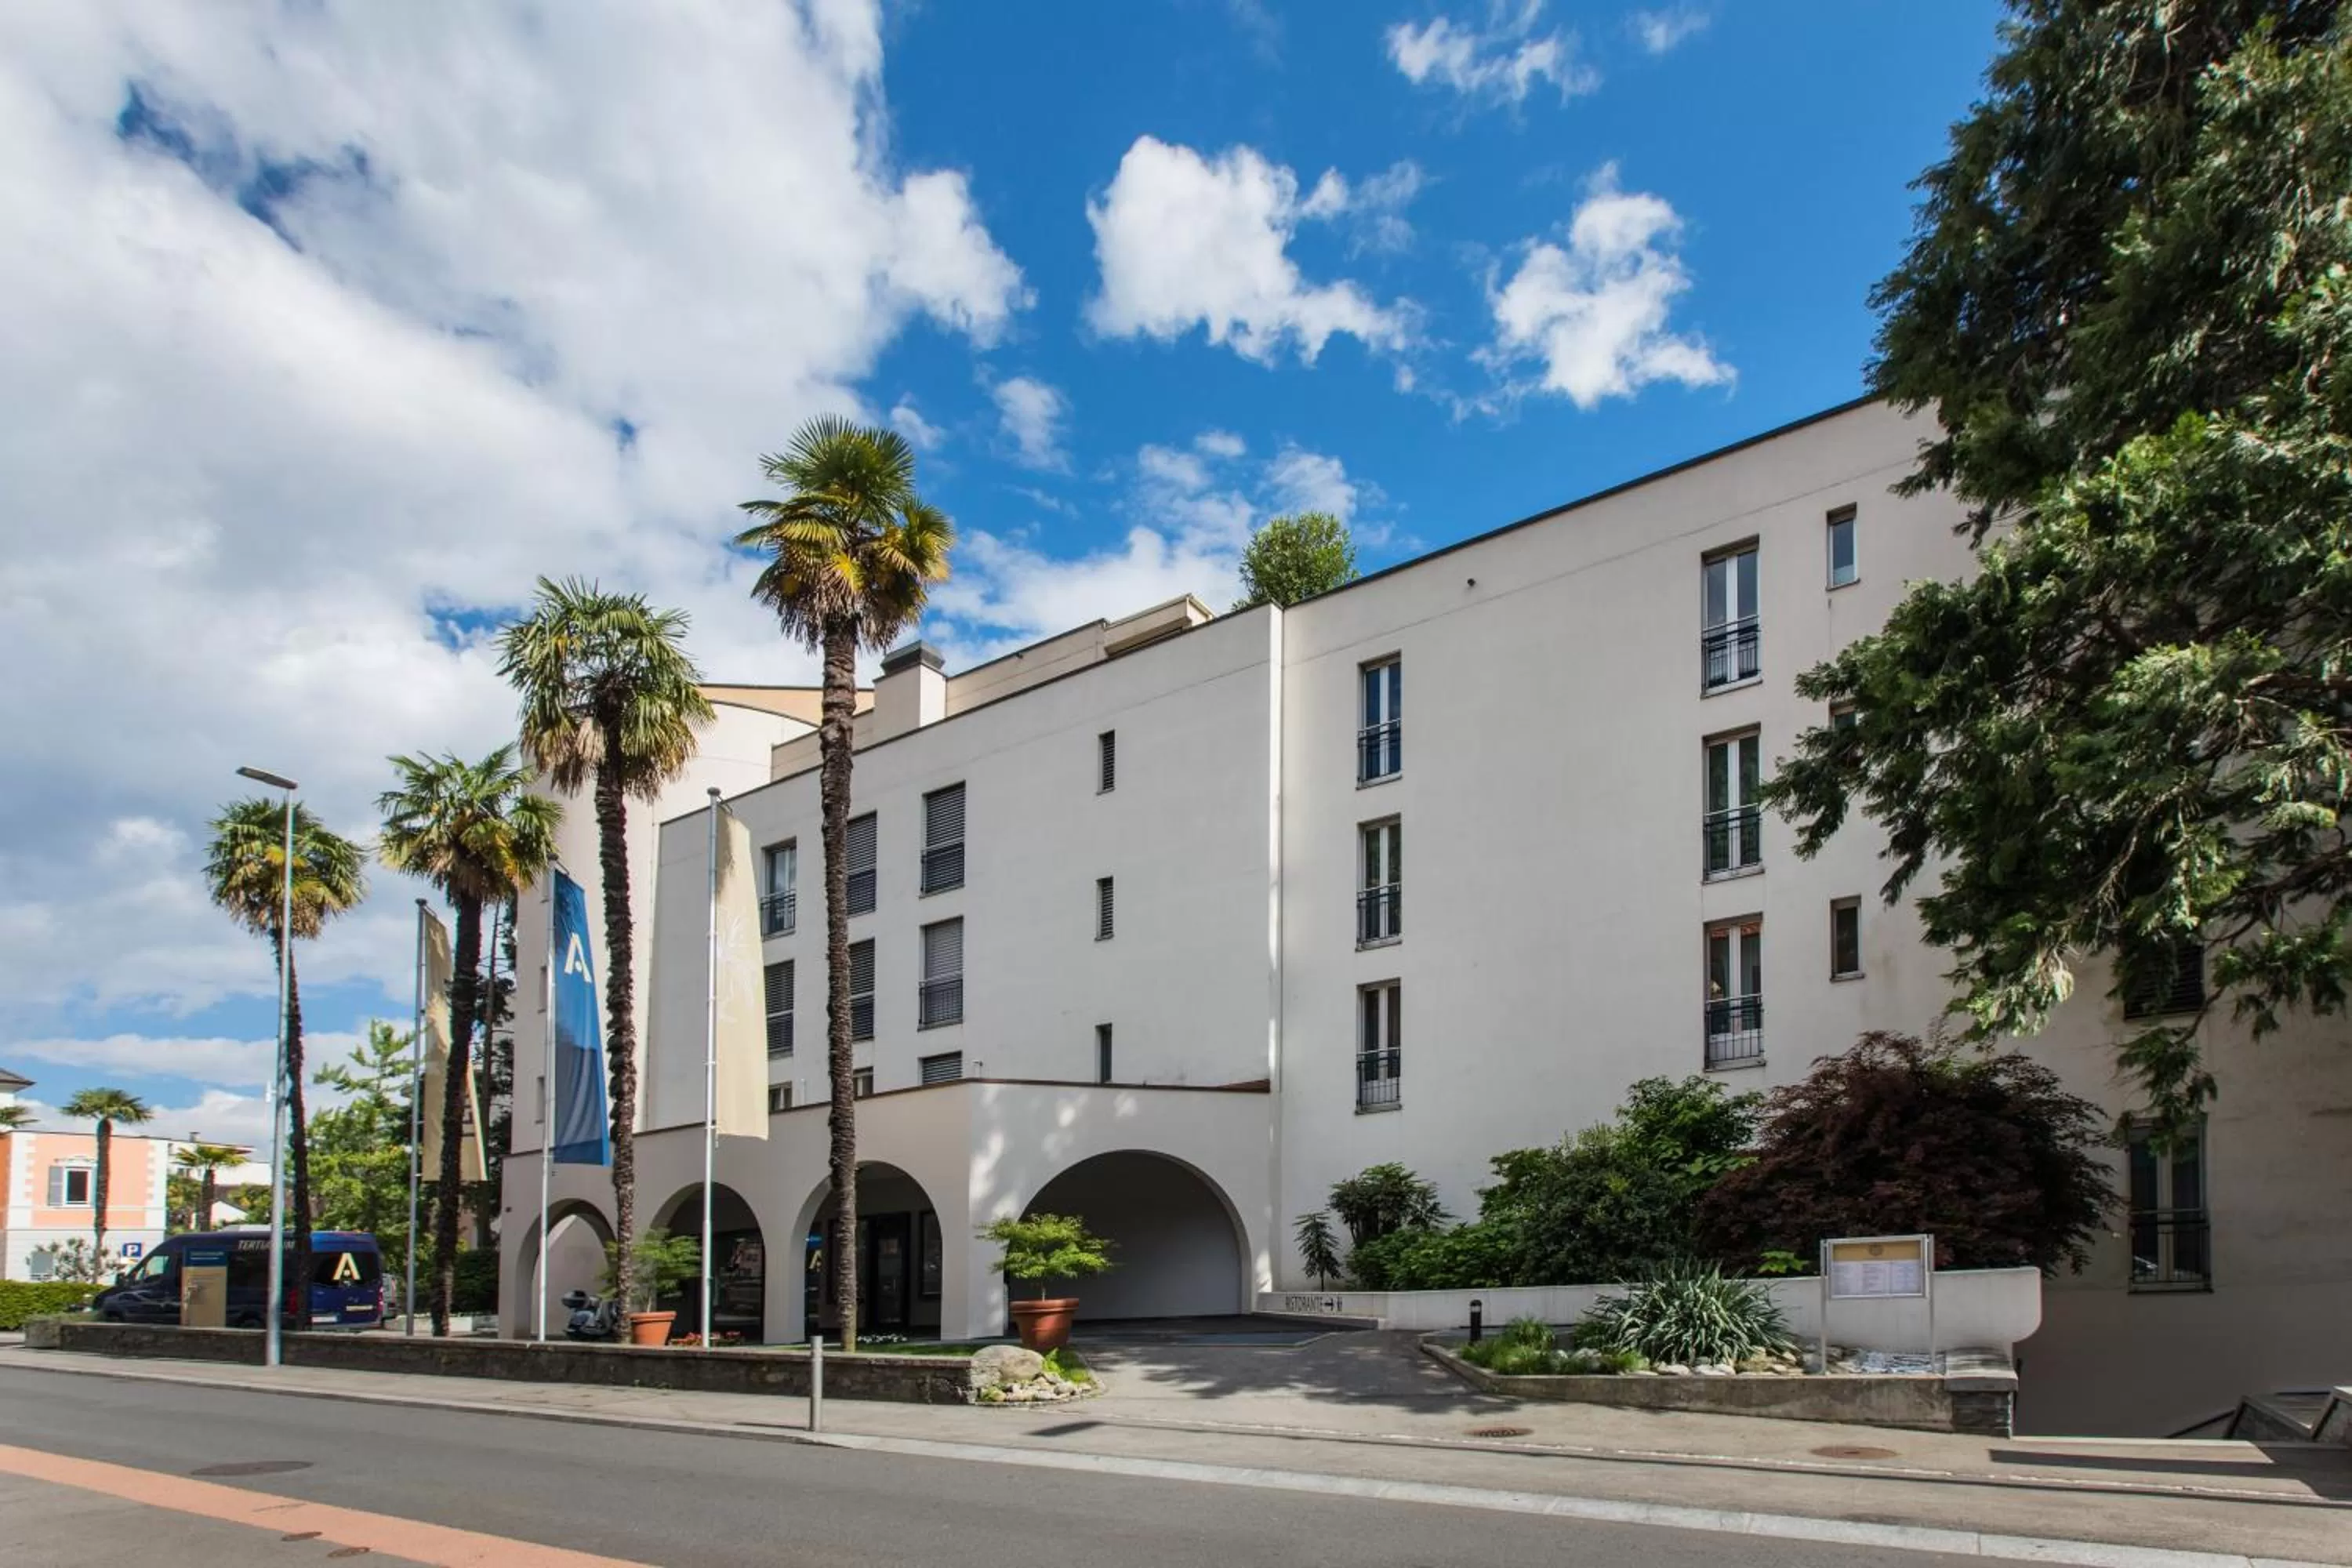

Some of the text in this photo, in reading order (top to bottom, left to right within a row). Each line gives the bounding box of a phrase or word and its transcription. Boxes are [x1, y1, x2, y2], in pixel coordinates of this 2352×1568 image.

[564, 932, 592, 983] A
[126, 1244, 139, 1257] P
[238, 1240, 296, 1251] TERTIAM
[333, 1252, 361, 1280] A
